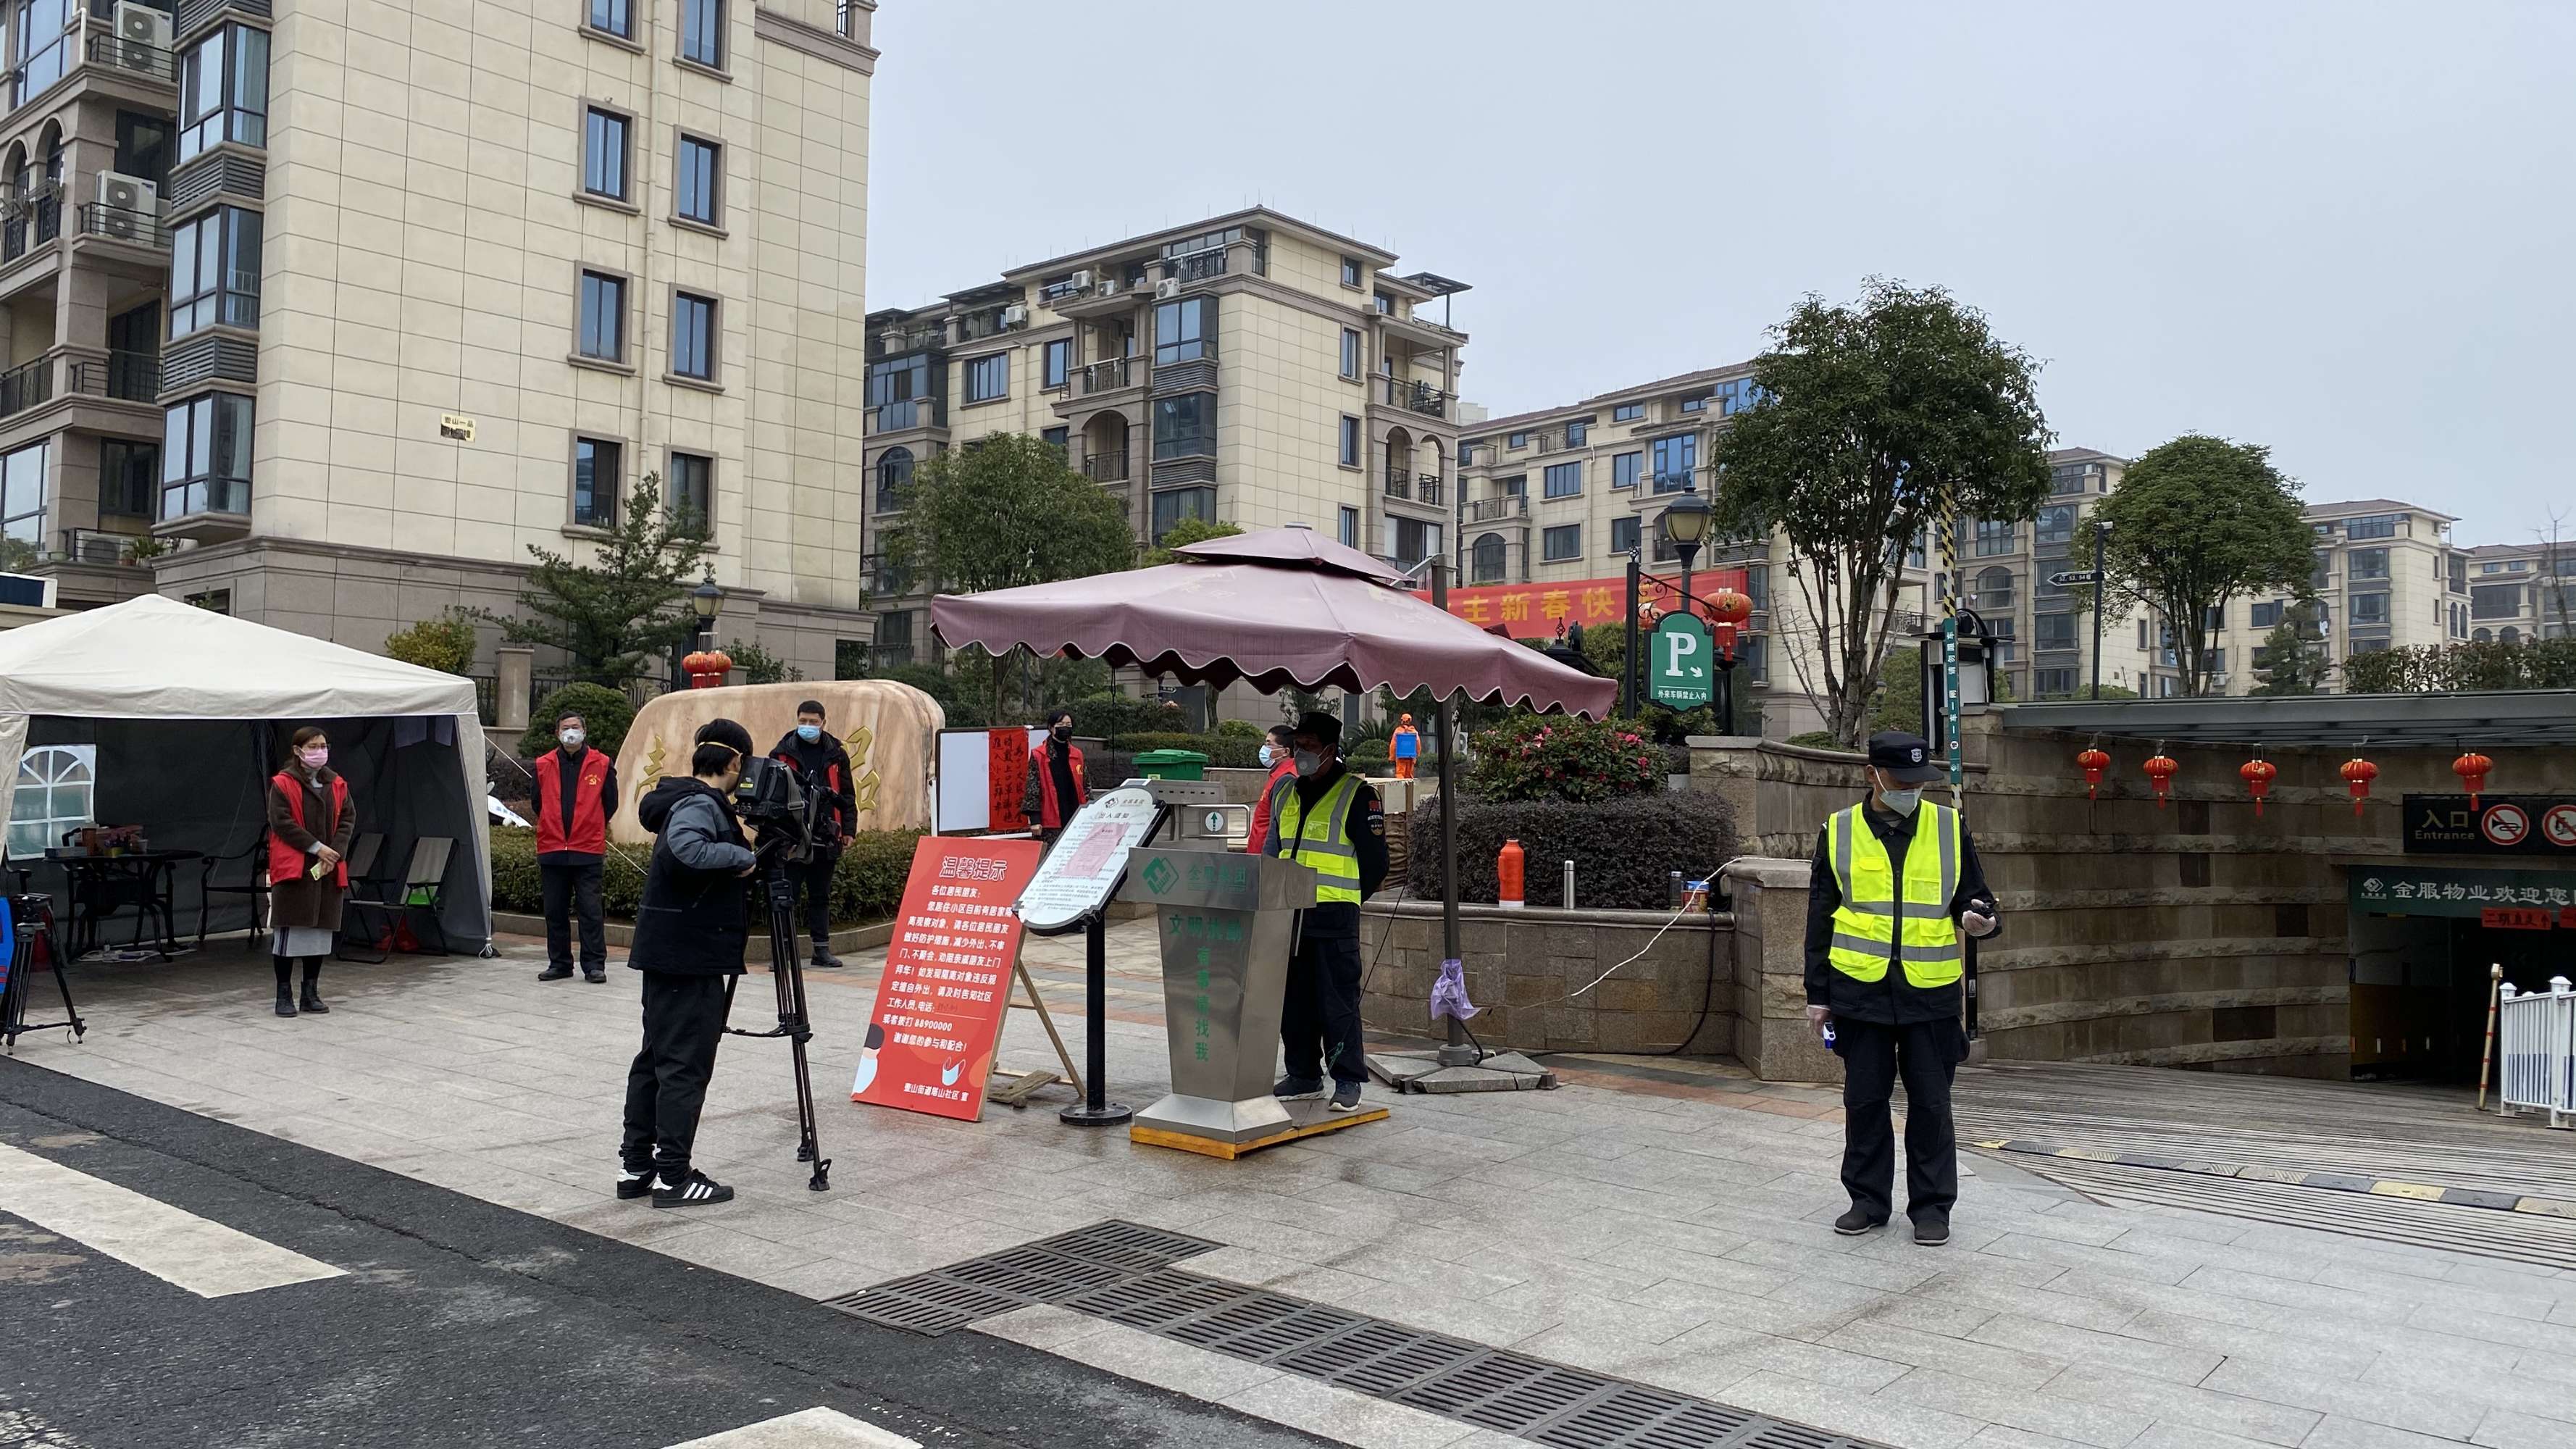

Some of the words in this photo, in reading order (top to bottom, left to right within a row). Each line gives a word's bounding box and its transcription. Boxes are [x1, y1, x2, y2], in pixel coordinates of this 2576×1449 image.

[1665, 632, 1697, 677] P
[1657, 689, 1707, 701] 外来车辆禁止入内
[2422, 809, 2469, 828] 入口
[2414, 830, 2476, 840] Entrance
[938, 855, 1008, 882] 温馨提示
[932, 885, 981, 898] 各位居民朋友：
[2392, 880, 2576, 906] 金服物业欢迎您
[882, 1014, 913, 1028] 或者拨打
[914, 1019, 953, 1032] 88900000
